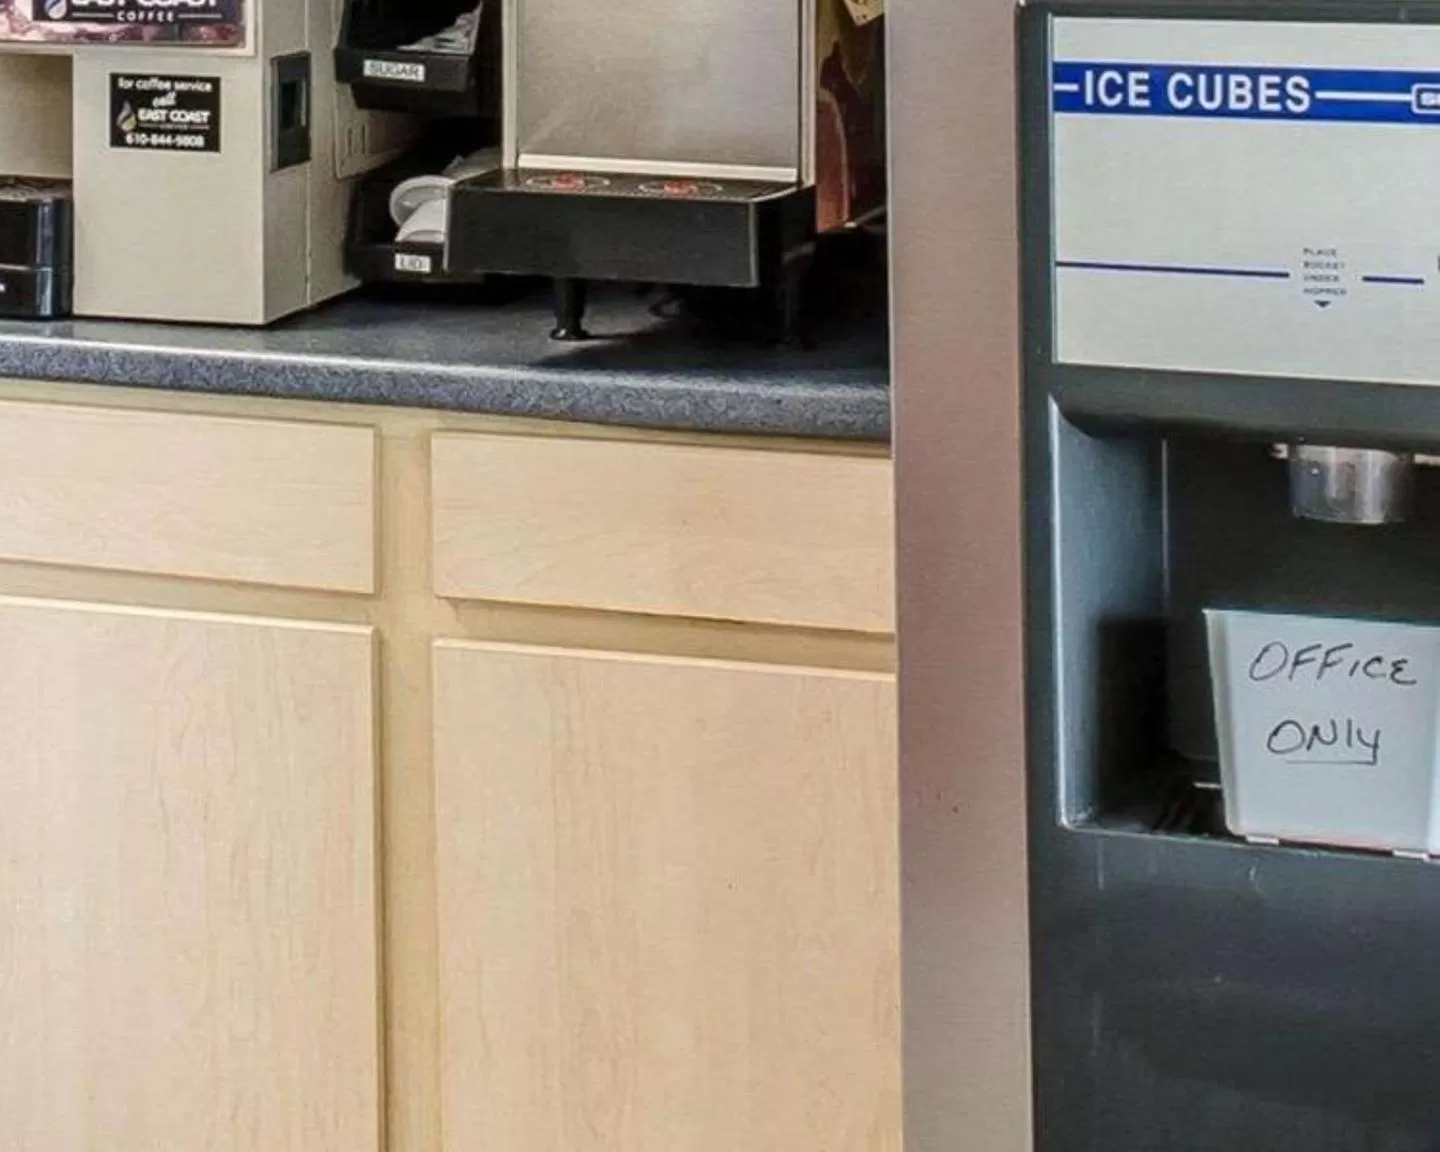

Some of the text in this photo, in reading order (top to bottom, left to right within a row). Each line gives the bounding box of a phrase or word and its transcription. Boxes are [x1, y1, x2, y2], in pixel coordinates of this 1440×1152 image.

[117, 11, 175, 23] COFFEE
[1084, 70, 1311, 113] ICE CUBES
[137, 108, 211, 123] EAST COAST
[1249, 641, 1418, 686] OFFICE
